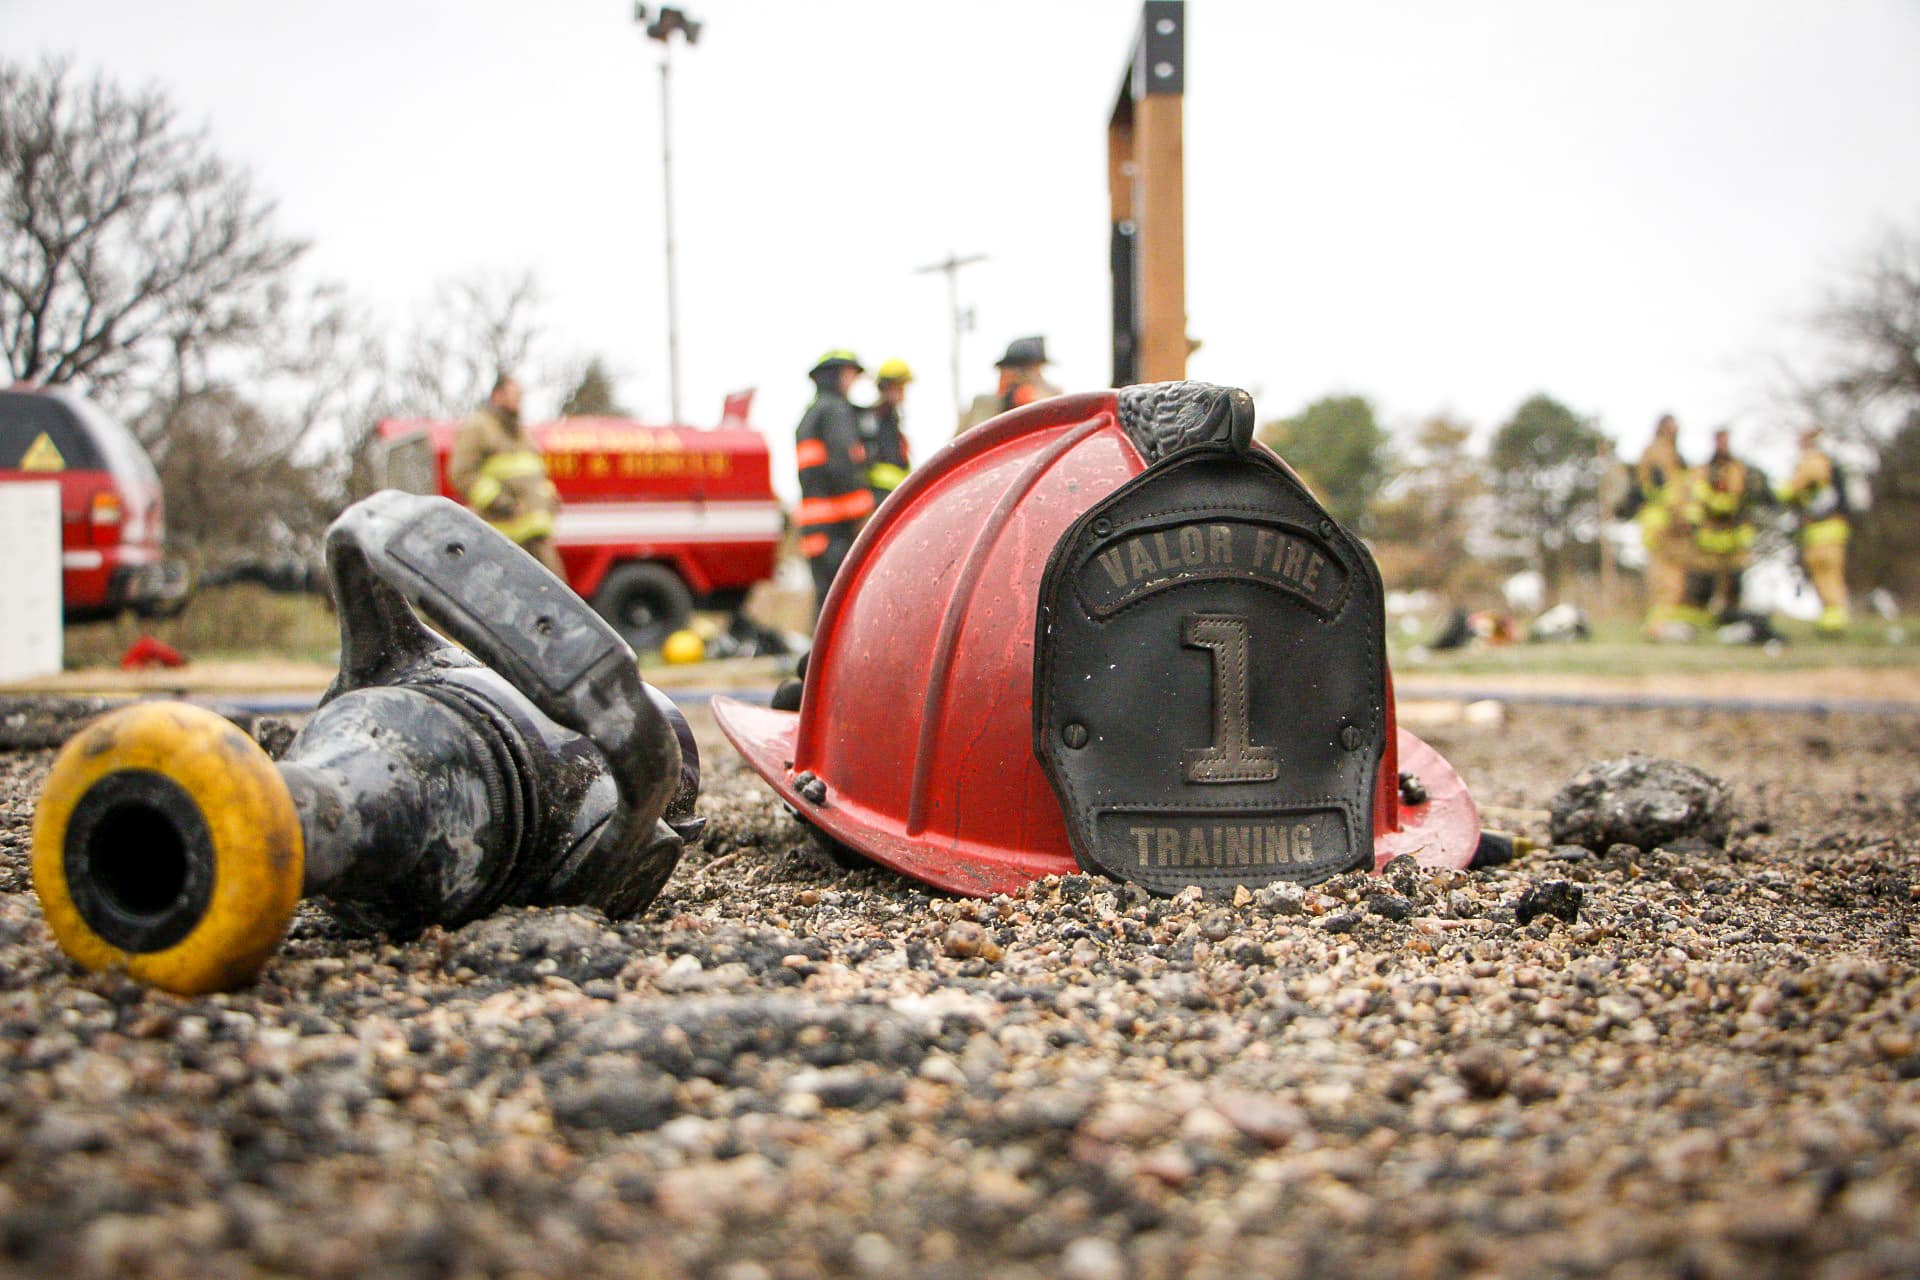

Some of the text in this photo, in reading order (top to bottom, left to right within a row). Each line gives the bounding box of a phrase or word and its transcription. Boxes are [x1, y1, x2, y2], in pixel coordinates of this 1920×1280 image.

[1099, 525, 1325, 592] VALOR FIRE
[1182, 614, 1279, 782] 1
[1130, 824, 1315, 867] TRAINING
